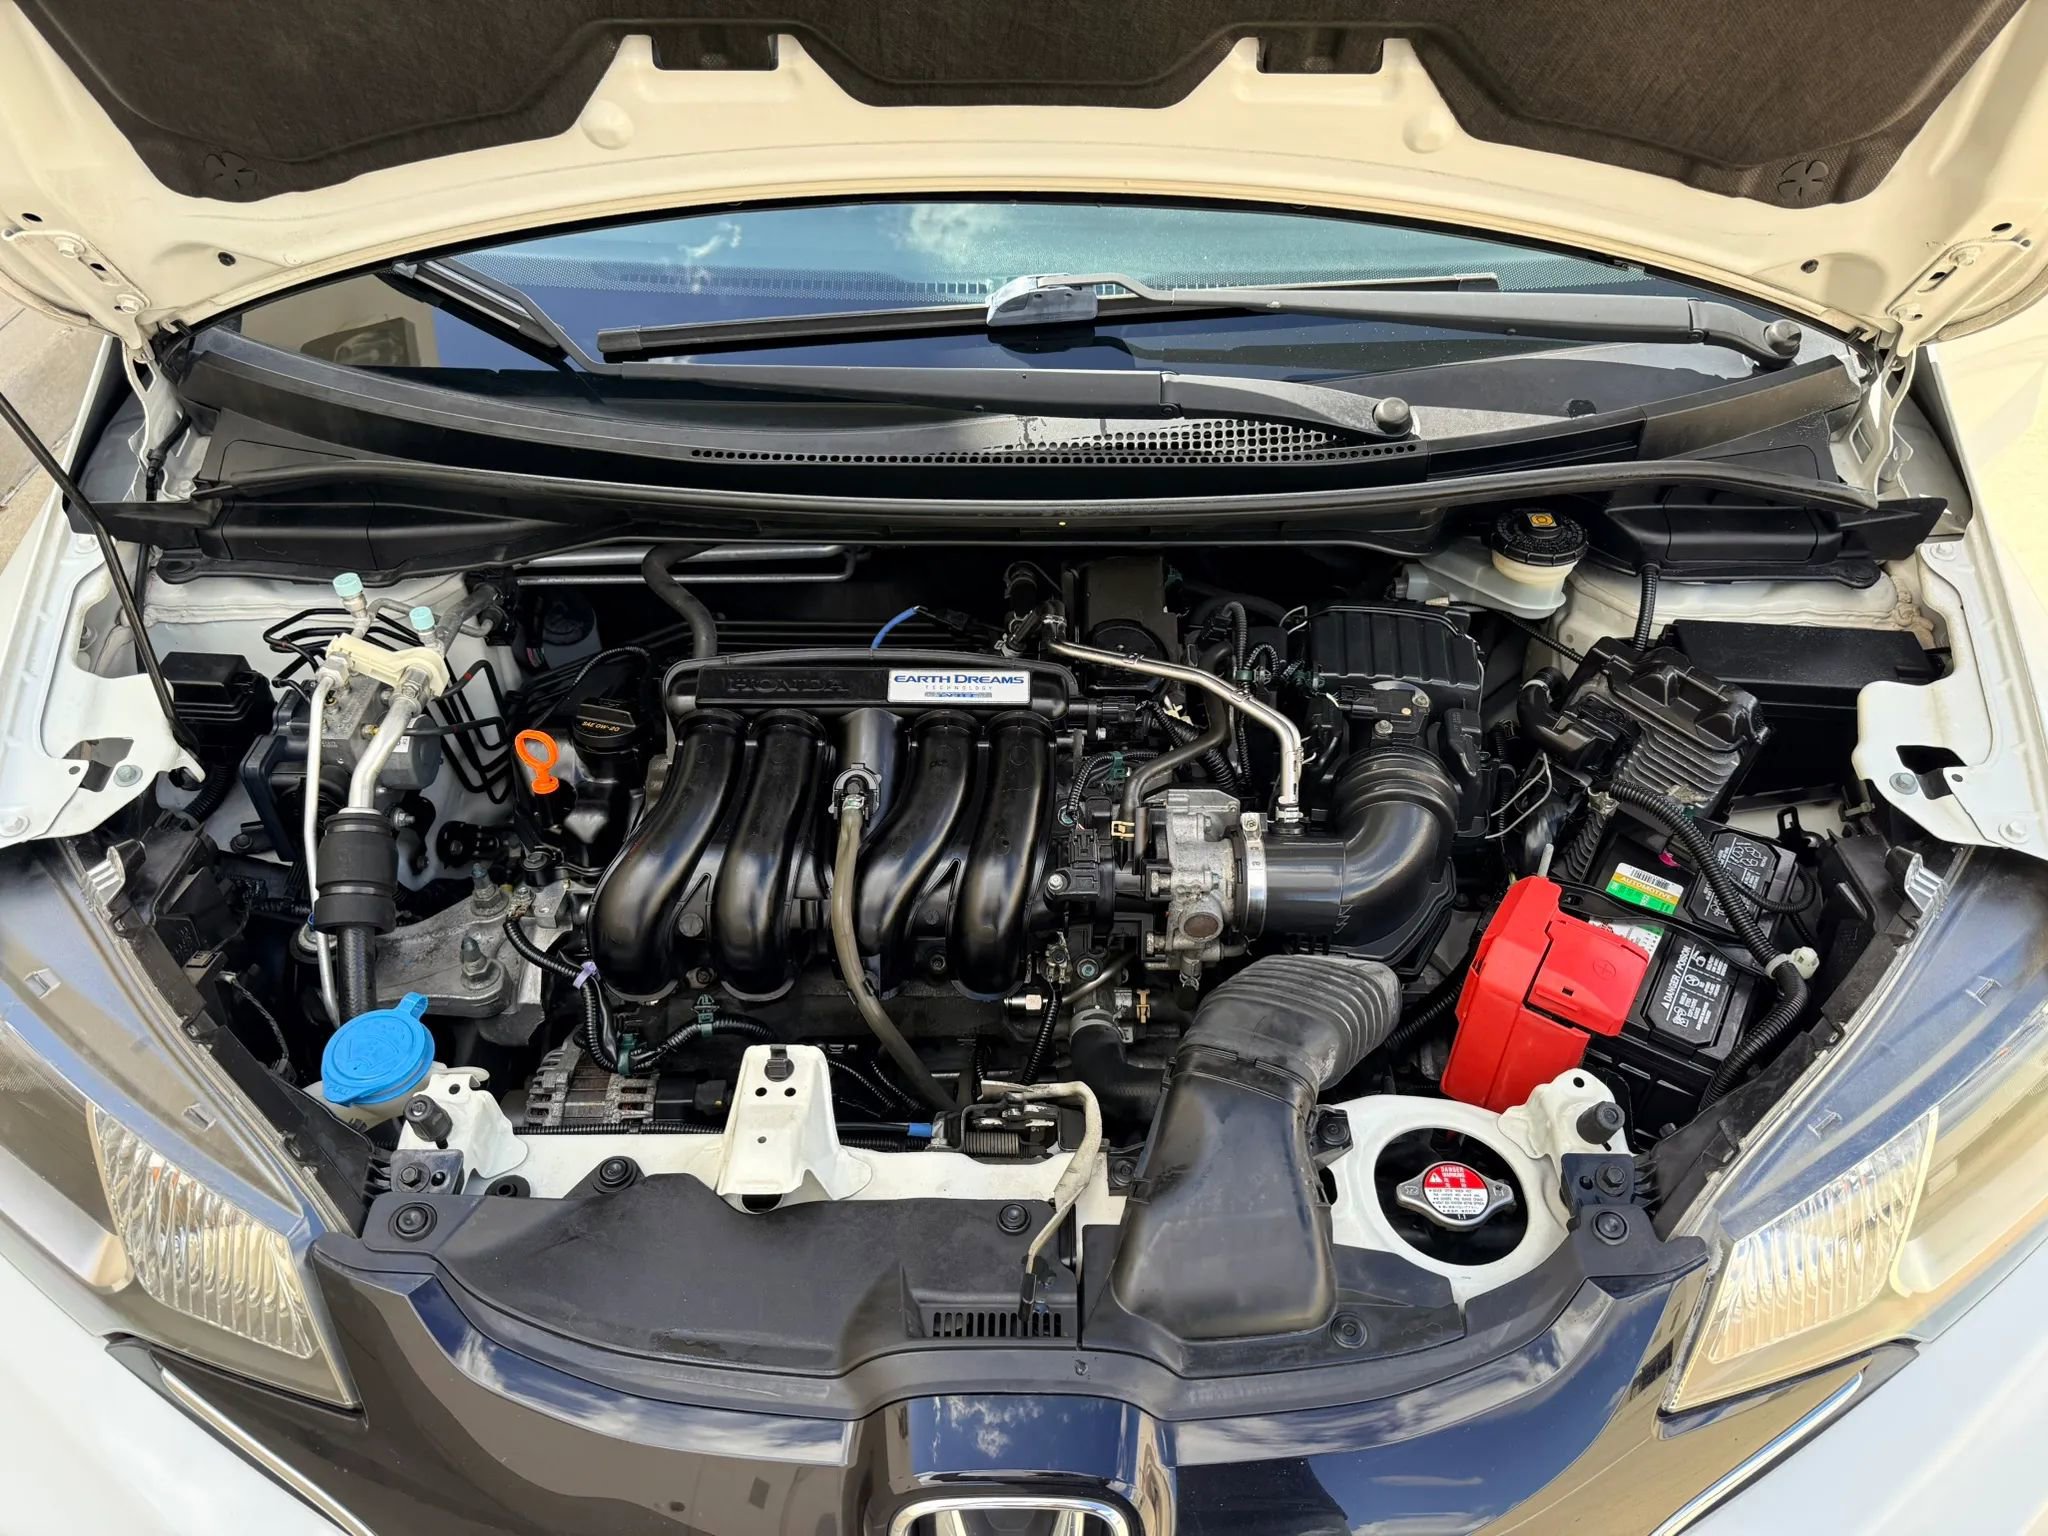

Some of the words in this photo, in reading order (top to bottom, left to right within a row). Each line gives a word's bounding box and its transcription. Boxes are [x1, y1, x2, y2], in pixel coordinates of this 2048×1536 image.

[727, 678, 849, 693] HONDA
[894, 675, 950, 684] EARTH
[954, 674, 1025, 684] DREAMS
[1621, 877, 1672, 900] AUTOMOTIVE
[1663, 974, 1681, 1003] DANGER
[1675, 945, 1691, 970] POISON
